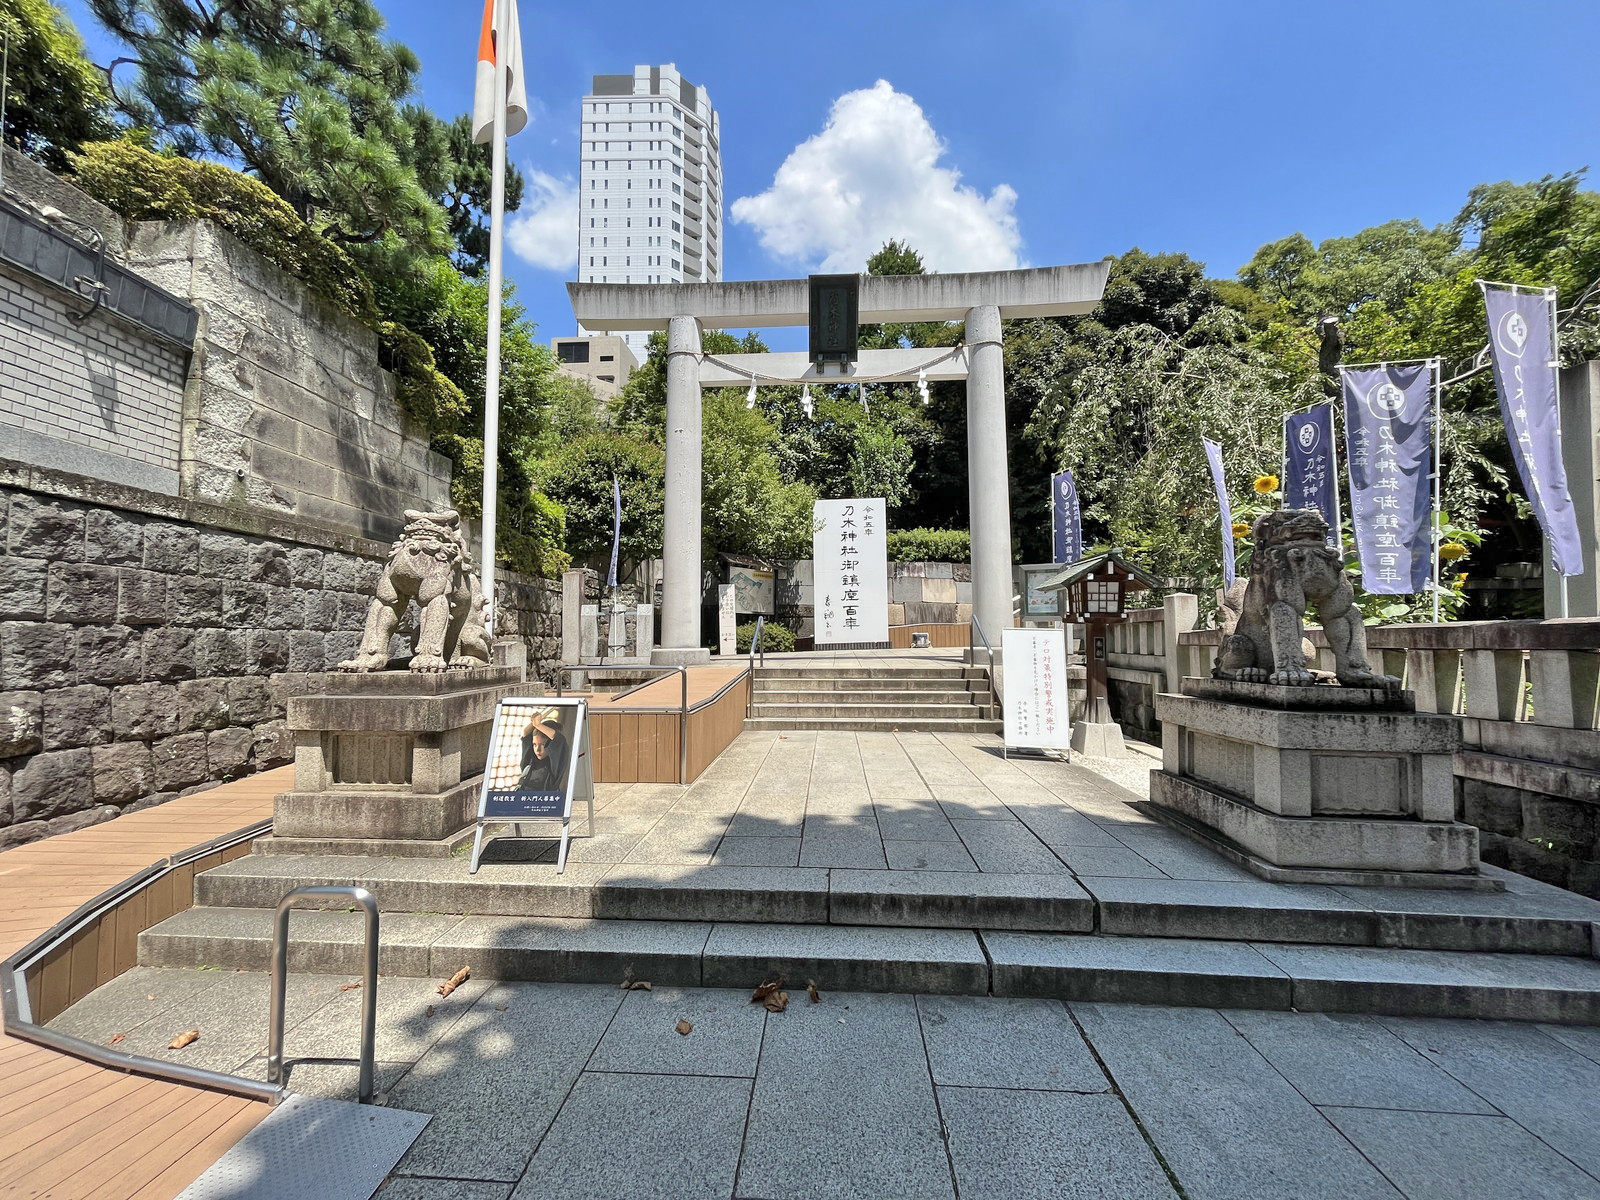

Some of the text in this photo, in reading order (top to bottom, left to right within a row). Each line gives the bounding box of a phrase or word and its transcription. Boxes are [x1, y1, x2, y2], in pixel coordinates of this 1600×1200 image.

[840, 505, 860, 630] 乃木神社御鎮座百年
[863, 505, 874, 536] 令和五年
[1042, 639, 1055, 734] テロ対策特別警戒実施中
